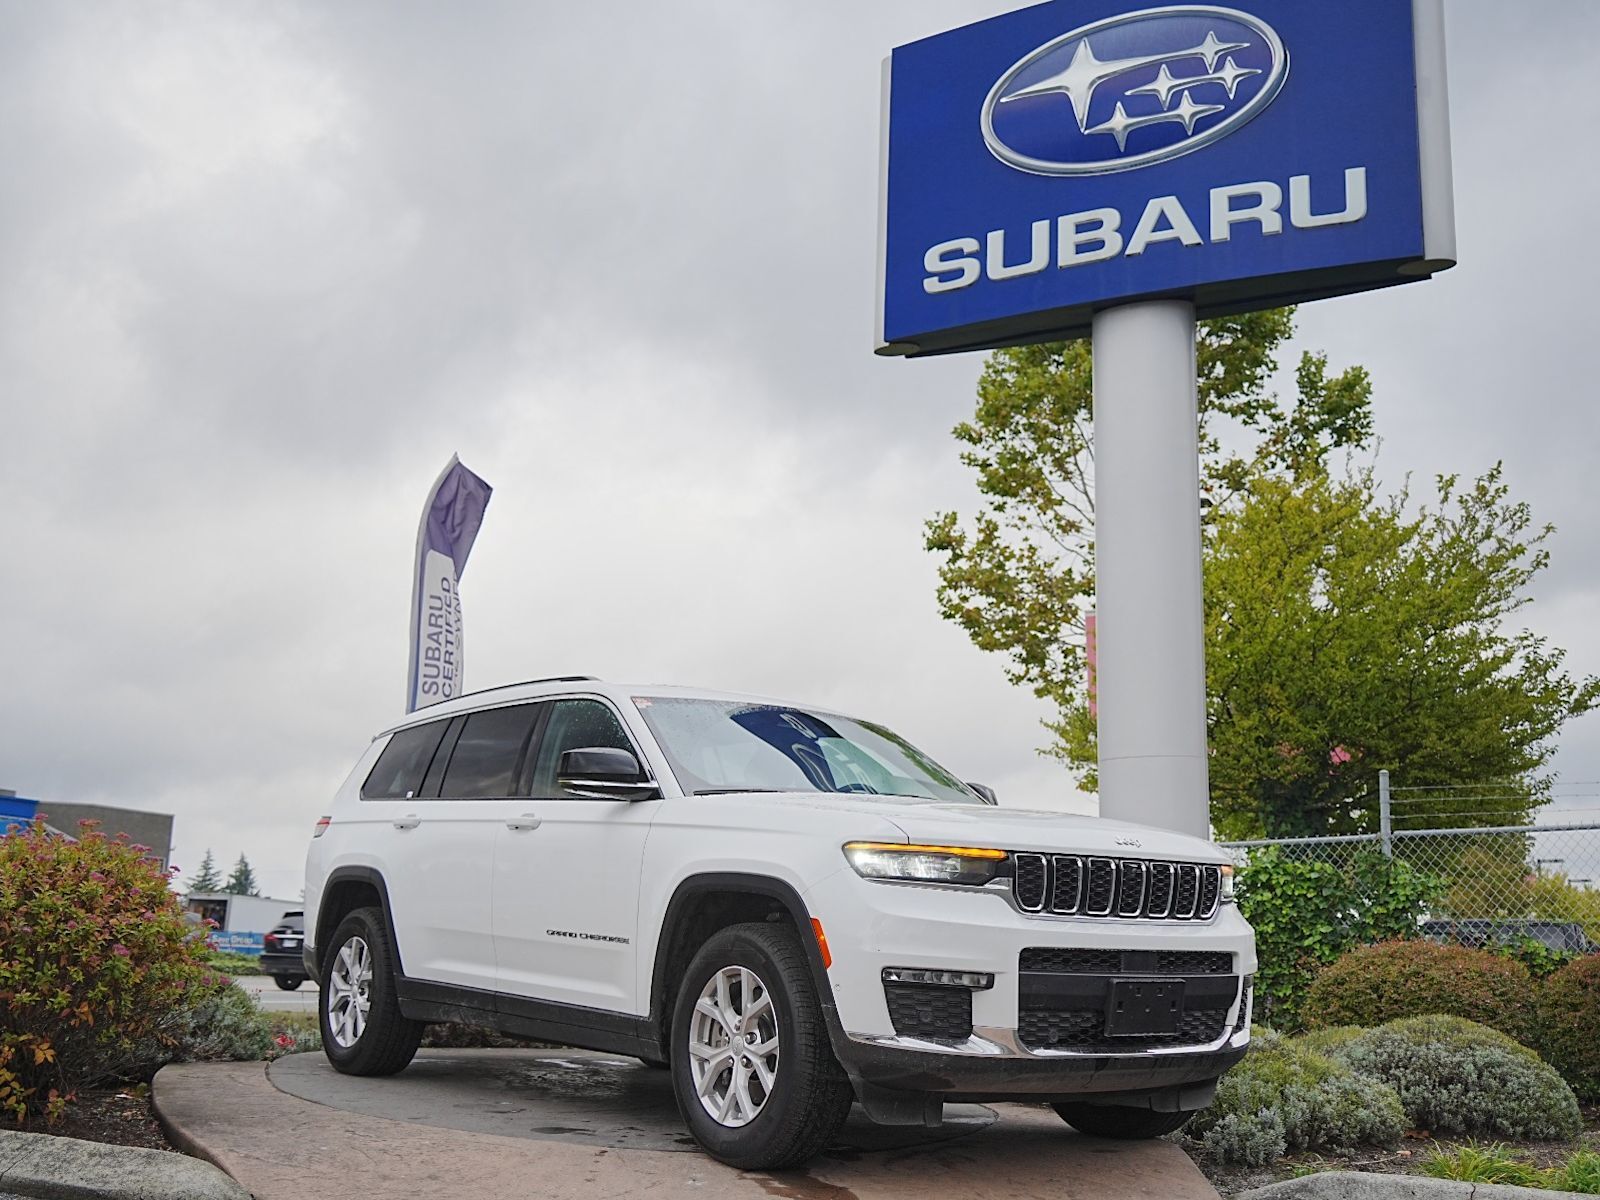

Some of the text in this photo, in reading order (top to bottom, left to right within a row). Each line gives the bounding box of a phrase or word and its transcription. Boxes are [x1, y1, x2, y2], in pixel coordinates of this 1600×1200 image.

[922, 166, 1367, 294] SUBARU
[422, 594, 444, 696] SUBARU
[441, 576, 454, 698] CERTIFIED
[546, 929, 629, 944] GRAND CHEROKEE
